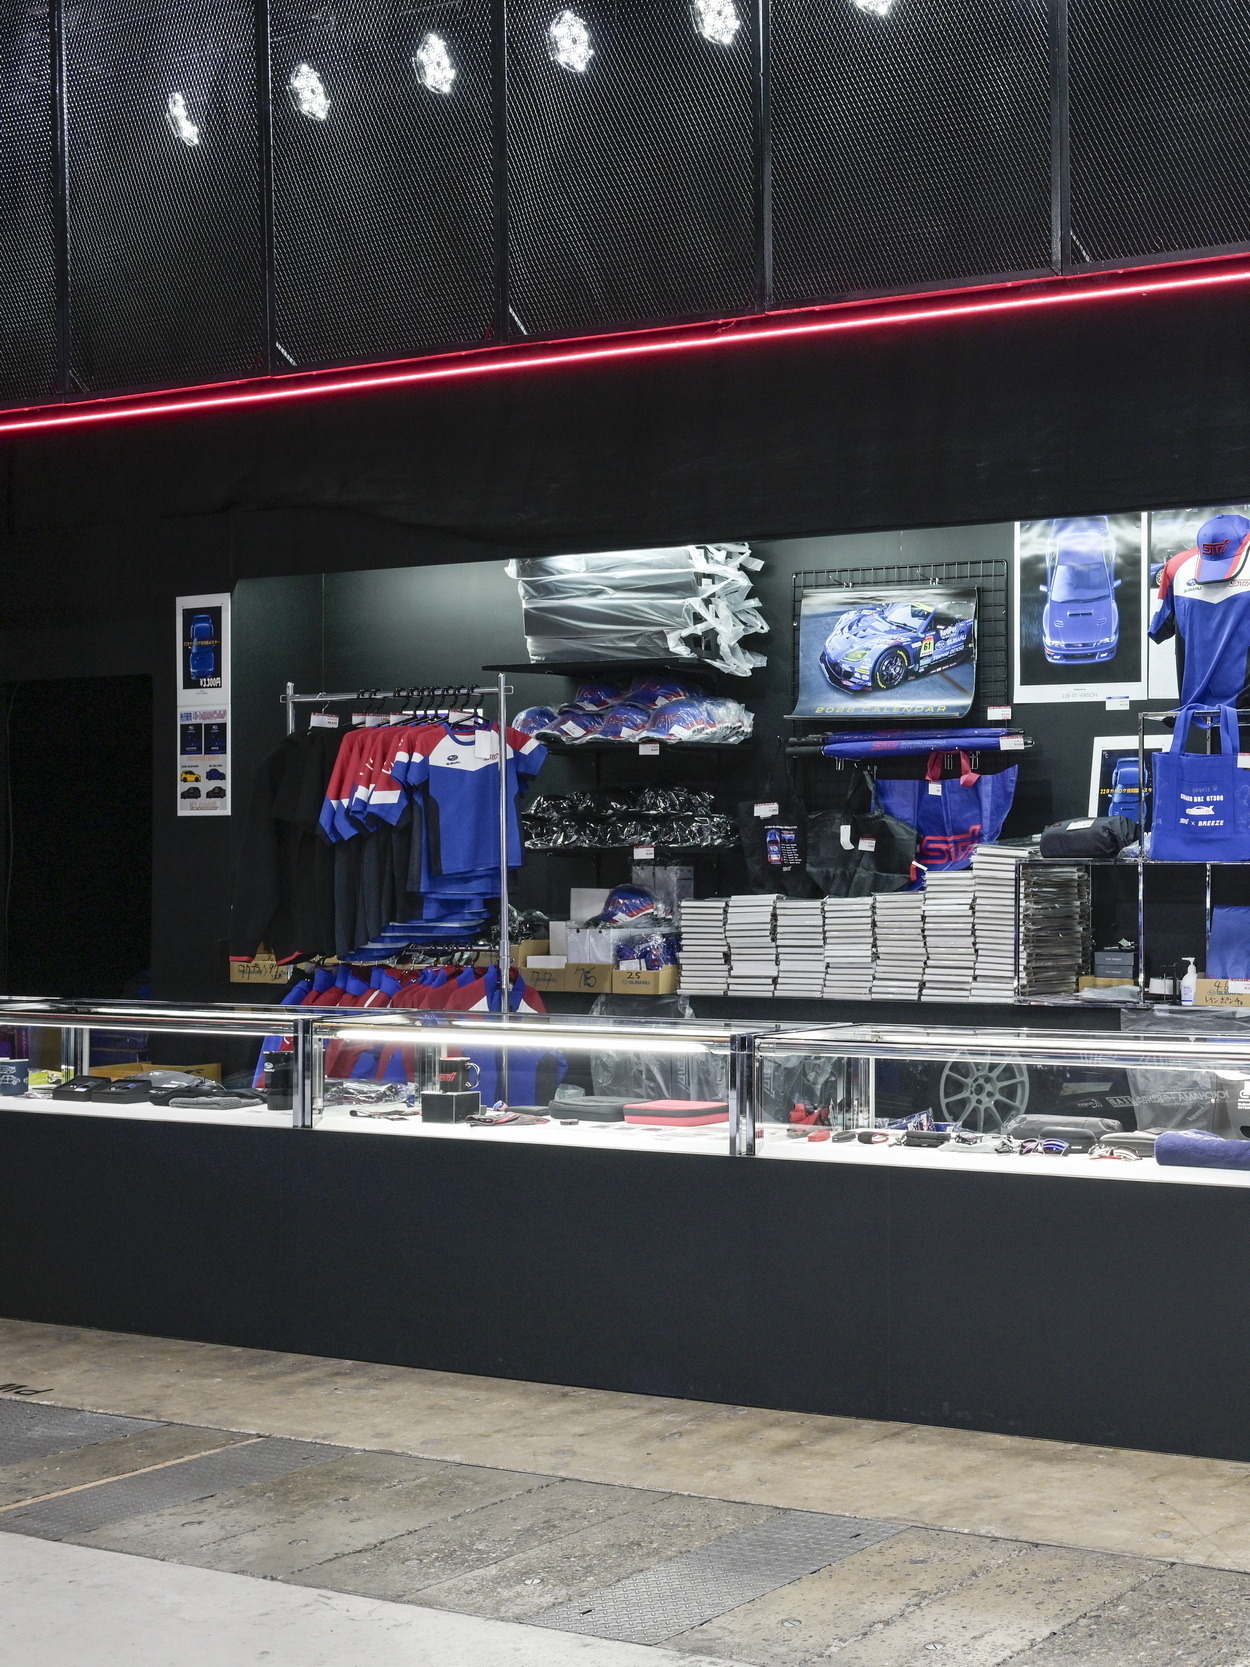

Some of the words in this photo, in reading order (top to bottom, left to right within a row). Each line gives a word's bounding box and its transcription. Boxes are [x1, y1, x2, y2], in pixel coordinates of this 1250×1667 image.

[923, 641, 932, 651] 61
[861, 705, 948, 713] CALENDAR
[626, 971, 641, 980] 25
